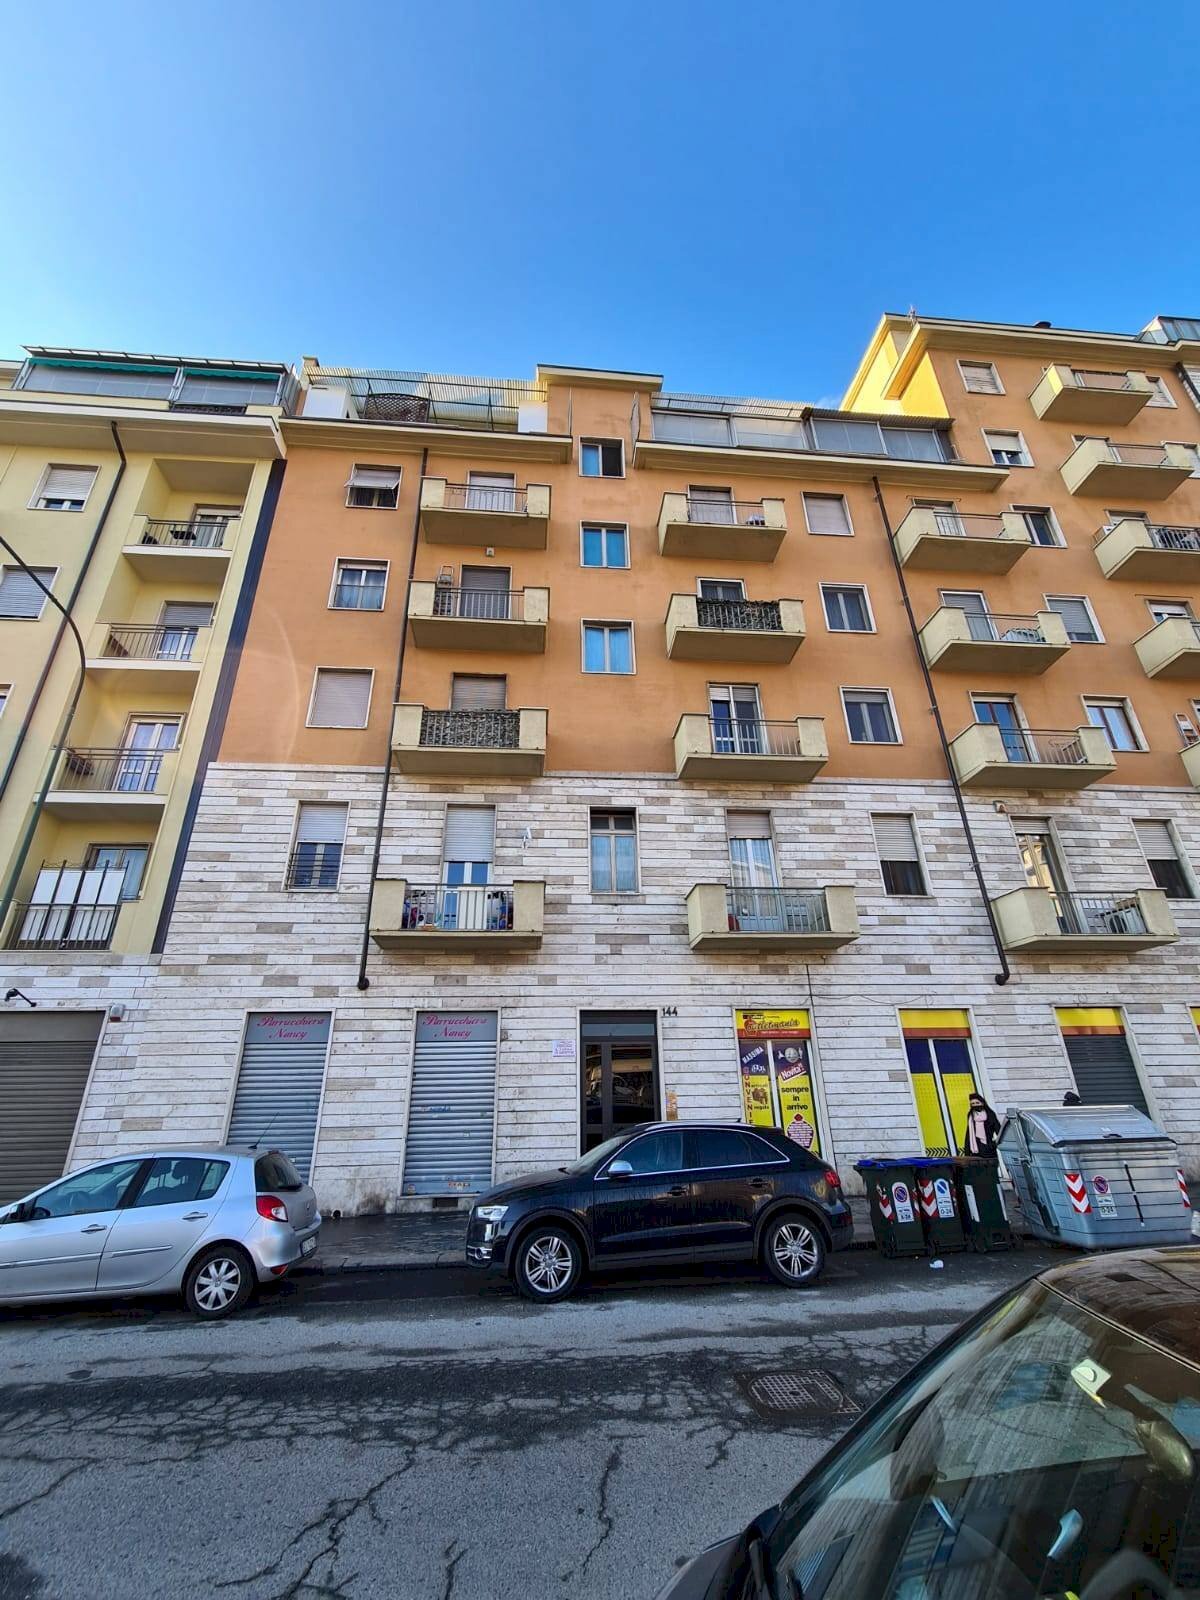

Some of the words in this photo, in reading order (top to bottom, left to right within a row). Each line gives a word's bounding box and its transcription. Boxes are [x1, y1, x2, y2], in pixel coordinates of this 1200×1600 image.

[661, 1006, 678, 1017] 144
[268, 1029, 307, 1040] Nancy
[433, 1026, 472, 1039] Nancy
